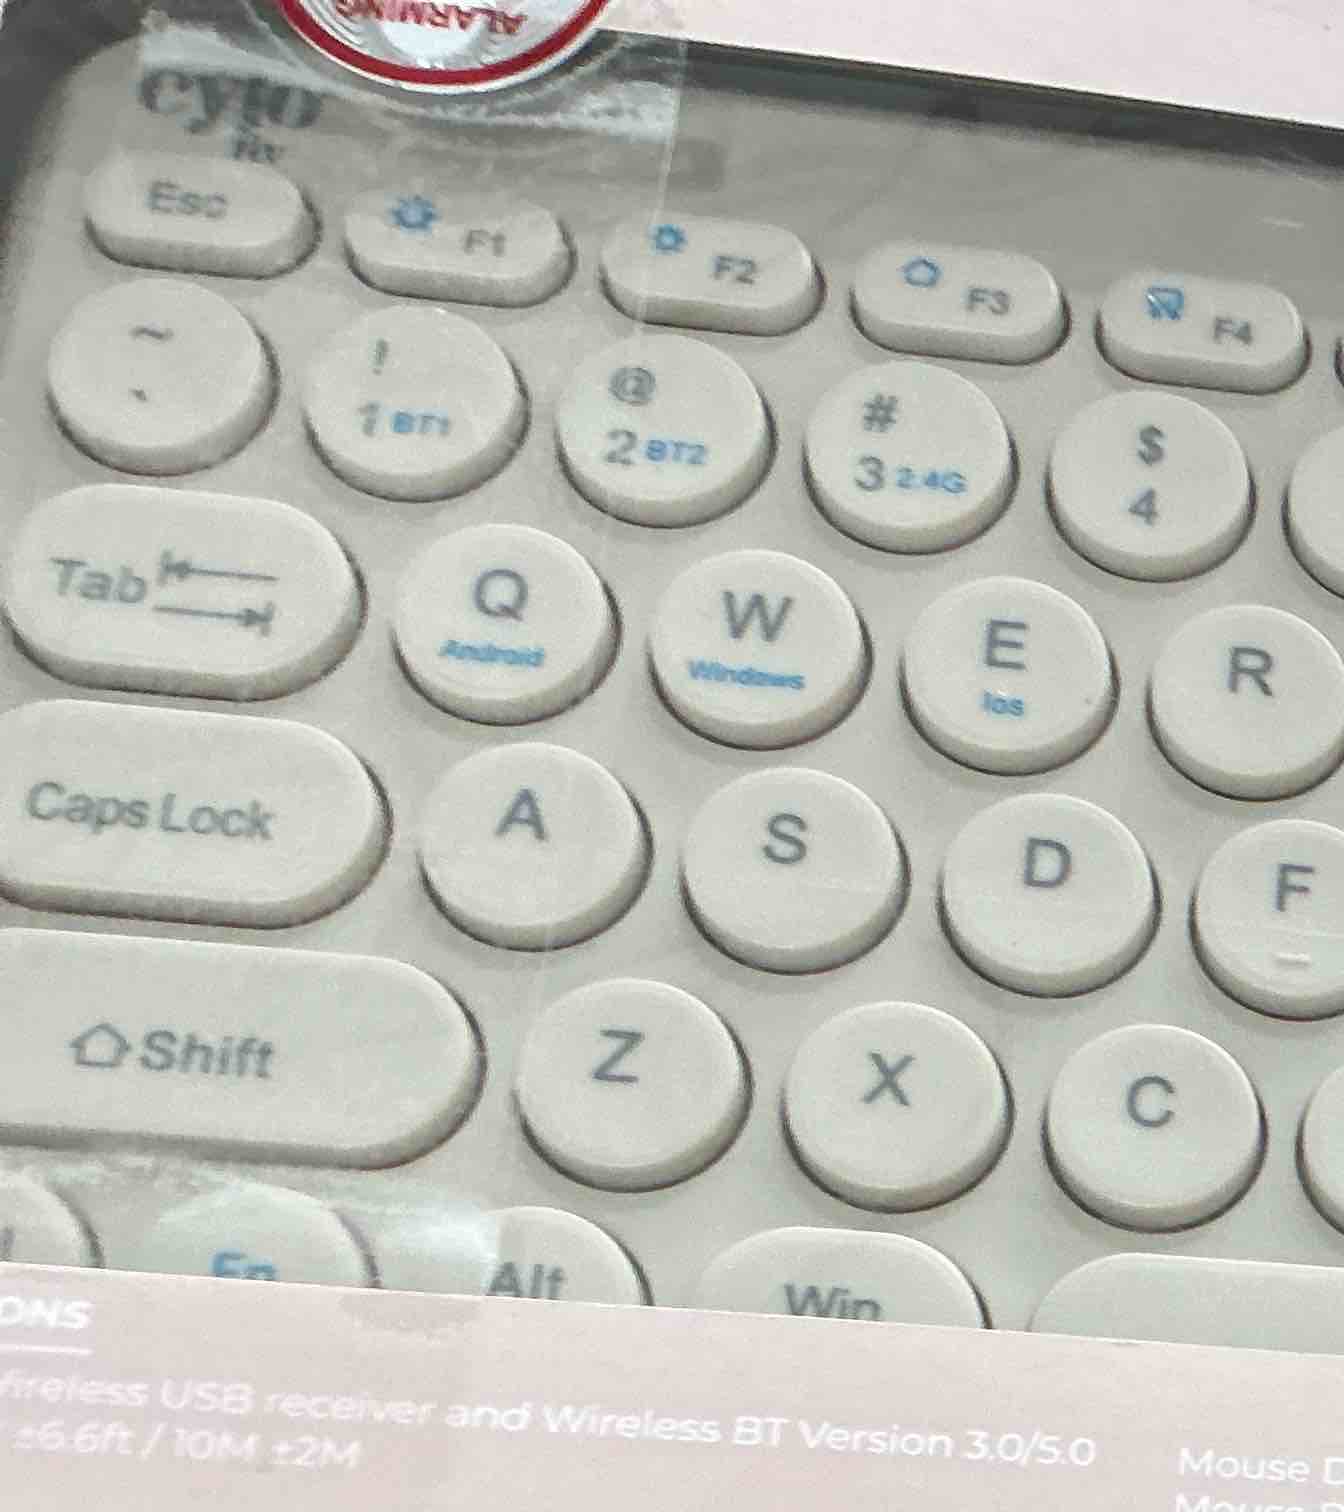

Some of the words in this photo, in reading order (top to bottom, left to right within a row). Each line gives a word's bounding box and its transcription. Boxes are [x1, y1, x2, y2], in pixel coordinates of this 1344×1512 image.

[147, 180, 227, 219] Esc
[464, 229, 505, 257] F1
[714, 256, 757, 286] F2
[966, 287, 1010, 316] F3
[1213, 316, 1254, 347] F4
[49, 557, 148, 605] Tab
[473, 569, 530, 624] Q
[722, 590, 794, 643] W
[439, 638, 546, 669] Android
[985, 618, 1028, 671] E
[686, 657, 806, 692] Windows
[1226, 645, 1275, 698] R
[26, 779, 147, 830] Caps
[158, 793, 276, 842] Lock
[494, 787, 548, 843] A
[762, 812, 810, 865] S
[1023, 837, 1073, 891] D
[1273, 863, 1316, 914] F
[140, 1028, 276, 1081] Shift
[591, 1028, 646, 1085] Z
[863, 1051, 915, 1107] X
[1125, 1074, 1178, 1128] C
[486, 1260, 566, 1300] Alt
[783, 1283, 882, 1323] Win
[160, 1378, 255, 1416] USB
[265, 1389, 437, 1425] receiver
[445, 1402, 531, 1432] and
[541, 1403, 721, 1445] Wireless
[731, 1414, 787, 1447] BT
[800, 1417, 953, 1459] Version
[964, 1430, 1097, 1468] 3.0/5.0
[1176, 1446, 1310, 1485] Mouse
